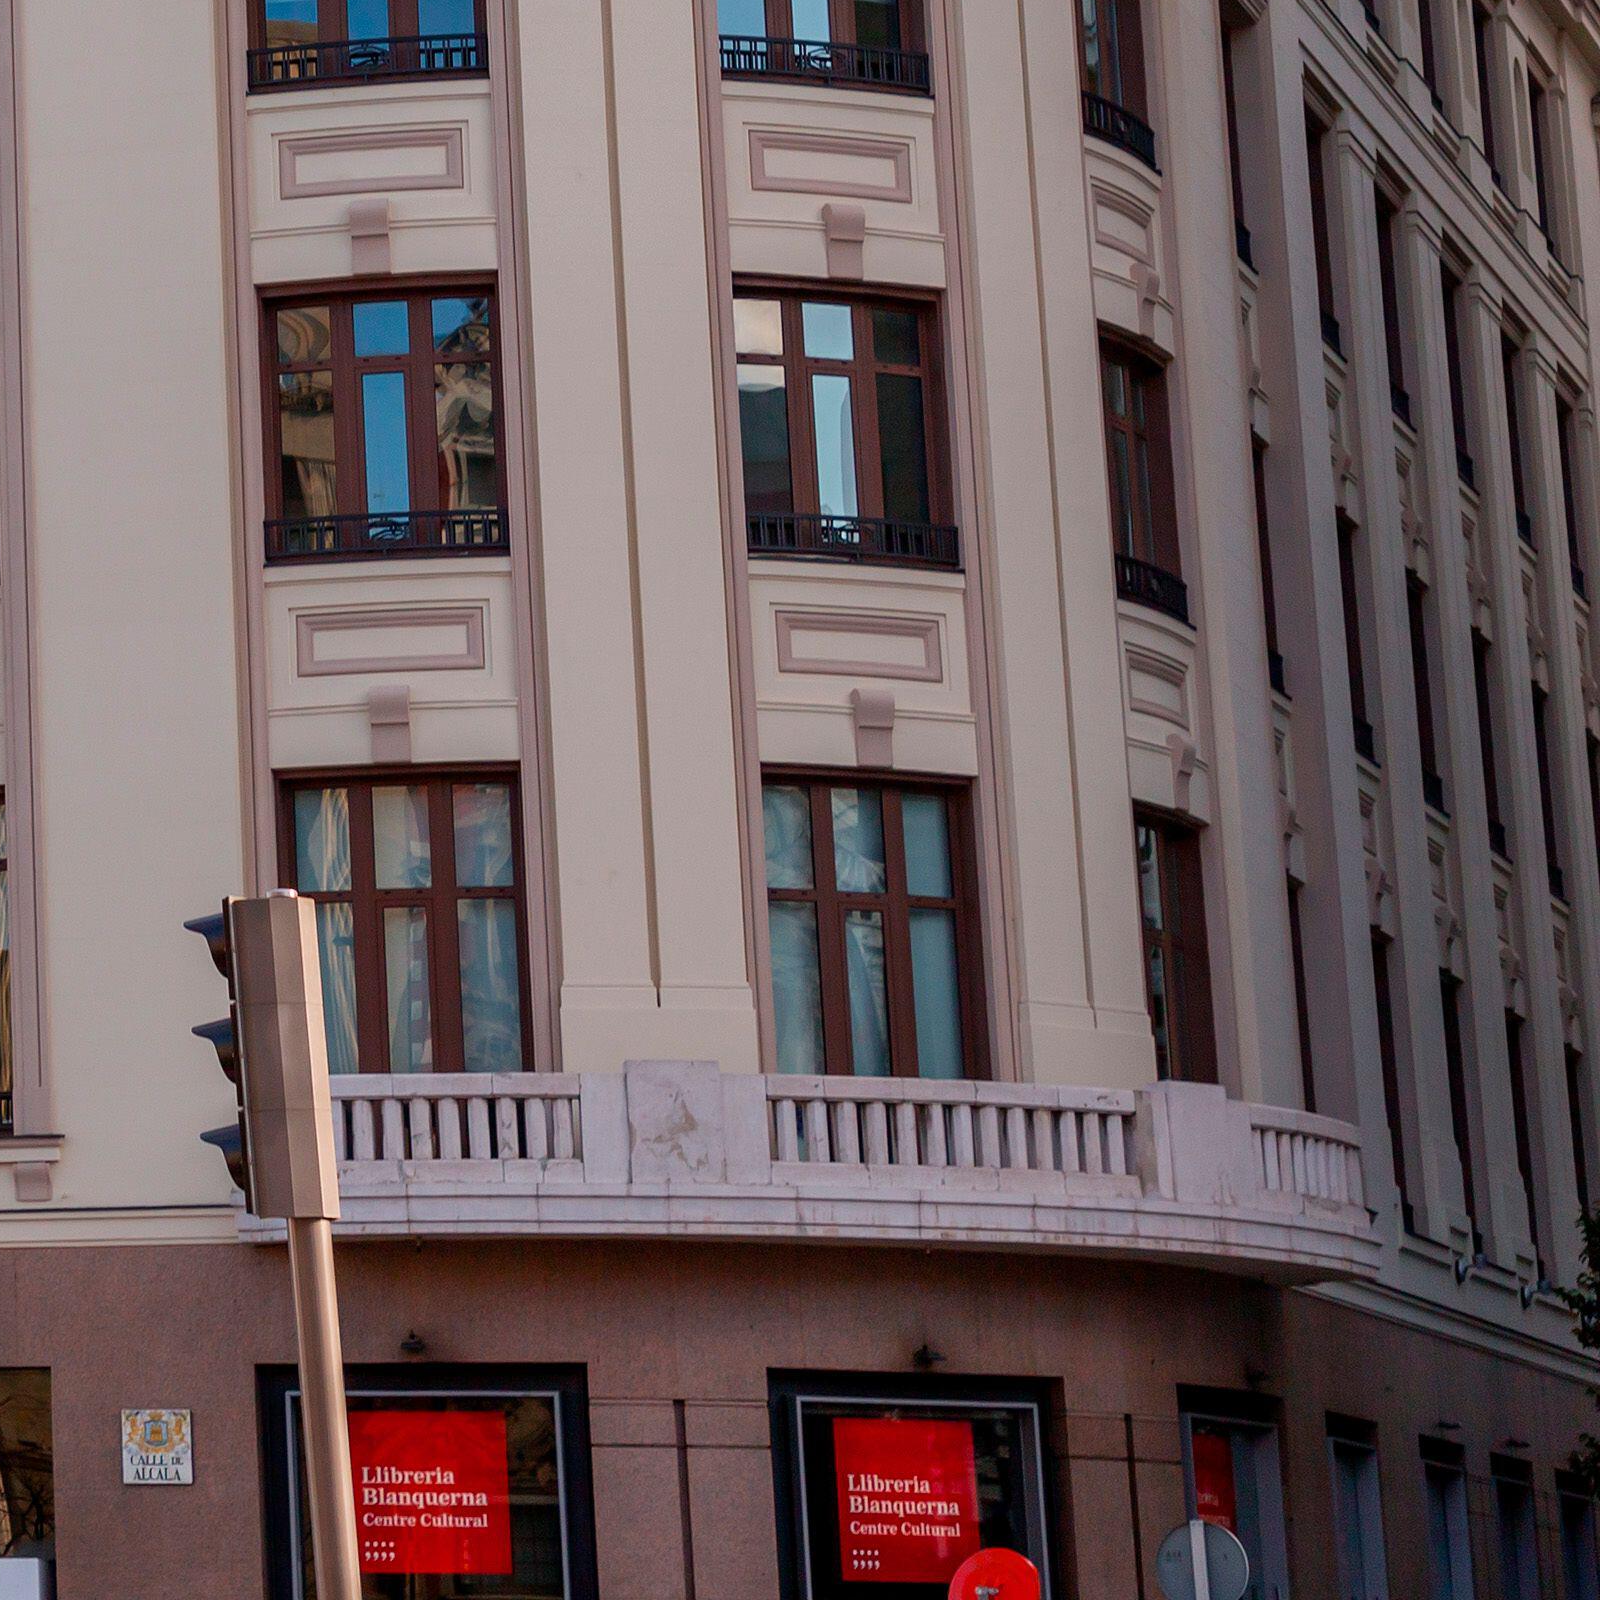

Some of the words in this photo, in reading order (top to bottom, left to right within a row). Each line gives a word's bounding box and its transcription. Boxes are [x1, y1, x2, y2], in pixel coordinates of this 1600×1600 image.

[130, 1454, 168, 1466] CALLE
[361, 1466, 455, 1485] Llibreria
[847, 1473, 931, 1493] Llibreria
[362, 1487, 488, 1509] Blanquerna
[849, 1495, 960, 1518] Blanquerna
[363, 1512, 416, 1527] Centre
[420, 1512, 488, 1528] Cultural
[850, 1520, 898, 1536] Centre
[901, 1521, 960, 1537] Cultural
